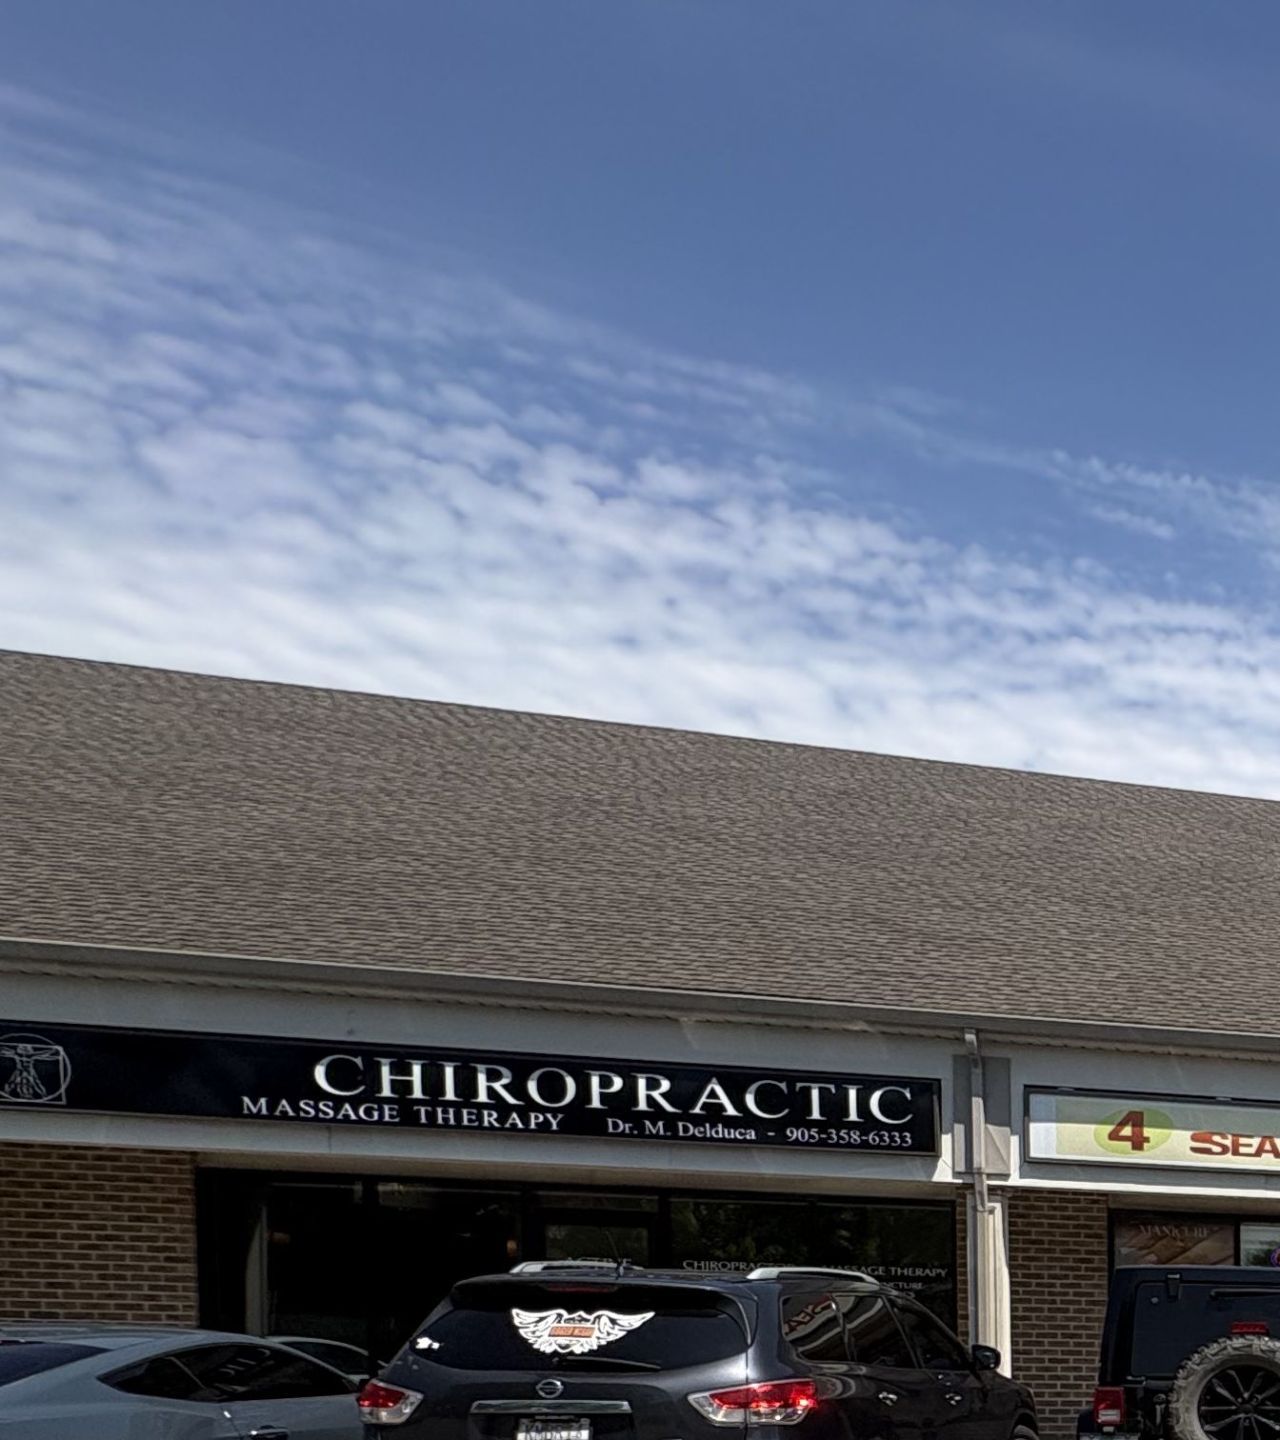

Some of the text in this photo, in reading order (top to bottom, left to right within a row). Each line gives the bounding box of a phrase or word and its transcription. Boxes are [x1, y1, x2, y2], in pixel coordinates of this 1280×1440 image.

[312, 1053, 914, 1125] CHIROPRACTIC
[242, 1096, 565, 1132] MASSAGE THERAPY
[1107, 1110, 1151, 1152] 4
[607, 1117, 638, 1136] Dr.
[644, 1119, 671, 1137] M.
[678, 1120, 757, 1141] Delduca
[786, 1126, 912, 1148] 905-358-6333
[889, 1266, 948, 1278] THERAPY
